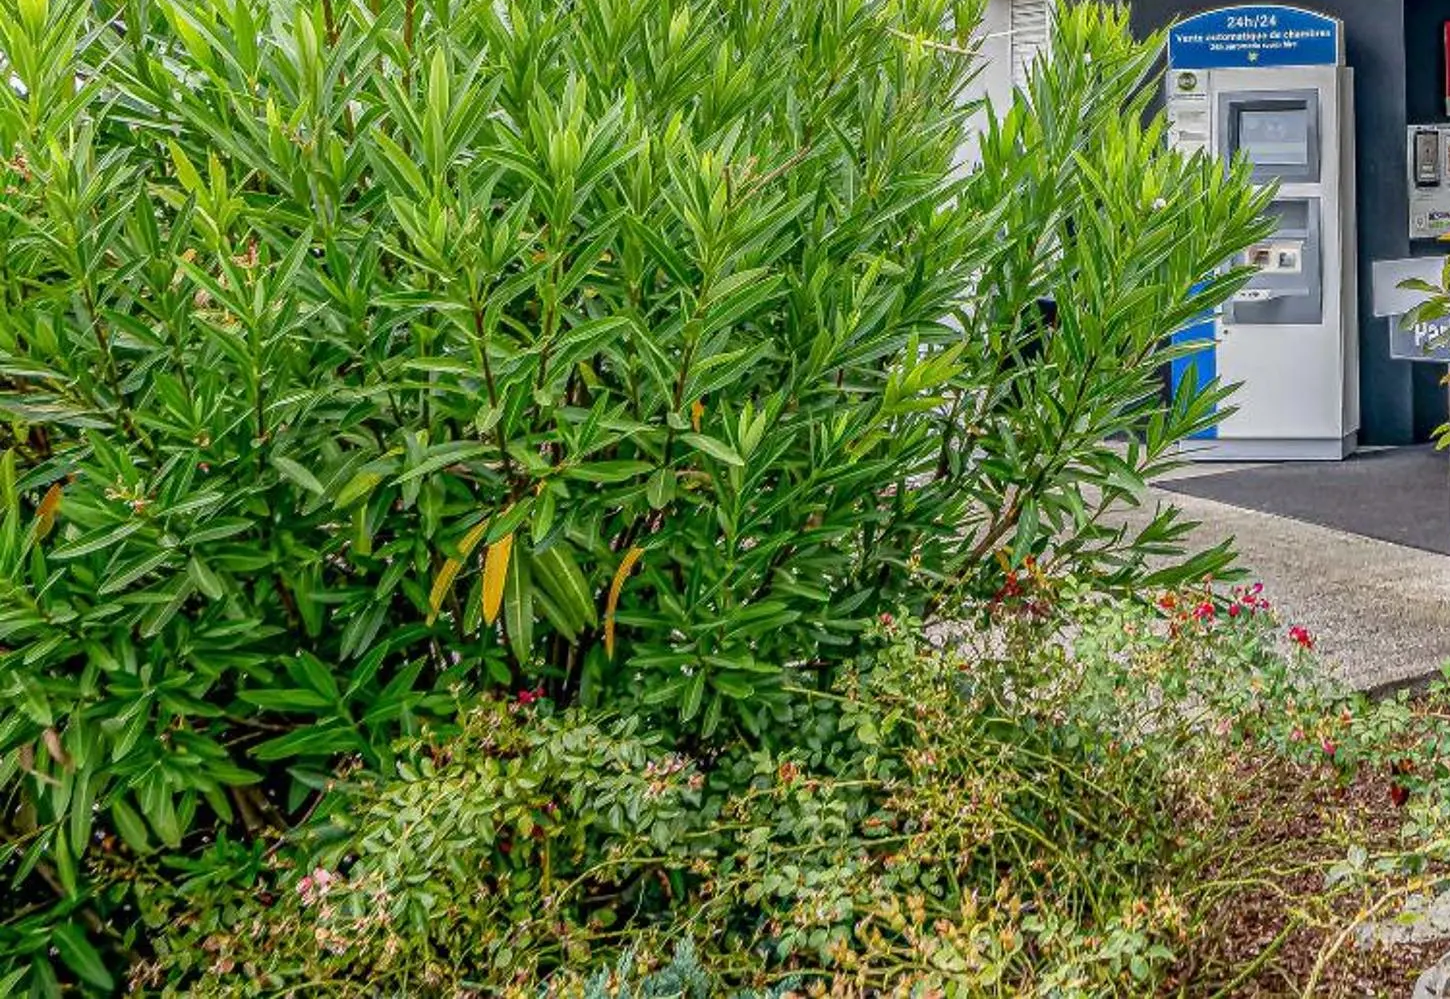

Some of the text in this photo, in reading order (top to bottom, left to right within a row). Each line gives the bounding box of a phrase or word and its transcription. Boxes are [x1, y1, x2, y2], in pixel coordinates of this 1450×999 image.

[1226, 14, 1278, 29] 24h/24
[1175, 33, 1204, 43] Vente
[1269, 30, 1282, 40] de
[1283, 29, 1331, 40] chambres
